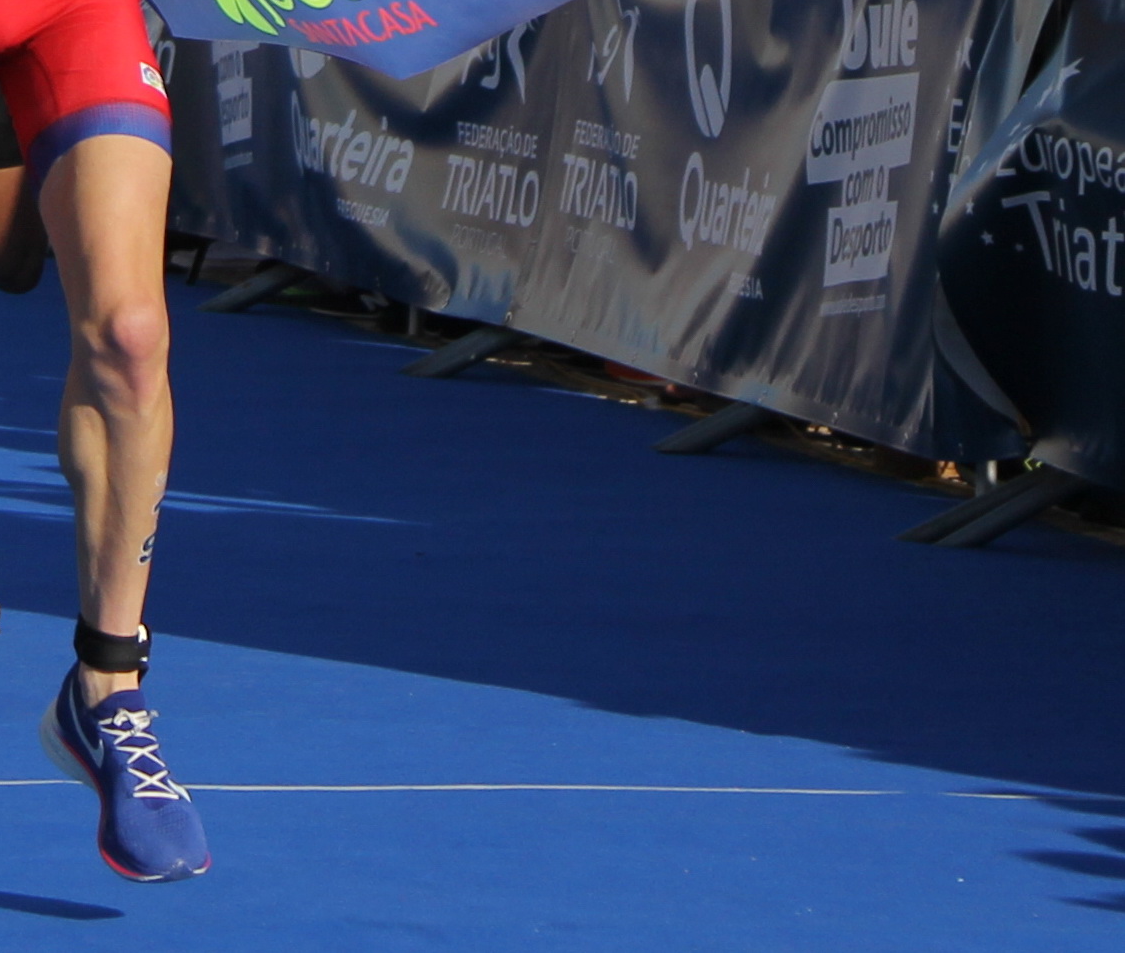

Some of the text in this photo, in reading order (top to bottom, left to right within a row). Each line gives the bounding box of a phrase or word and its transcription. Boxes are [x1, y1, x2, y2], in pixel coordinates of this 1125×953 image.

[290, 89, 415, 194] Quarteira
[523, 132, 539, 159] DE
[622, 132, 642, 160] DE
[810, 96, 912, 161] Compromisso
[441, 154, 541, 228] TRIATLO
[559, 153, 639, 232] TRIATLO
